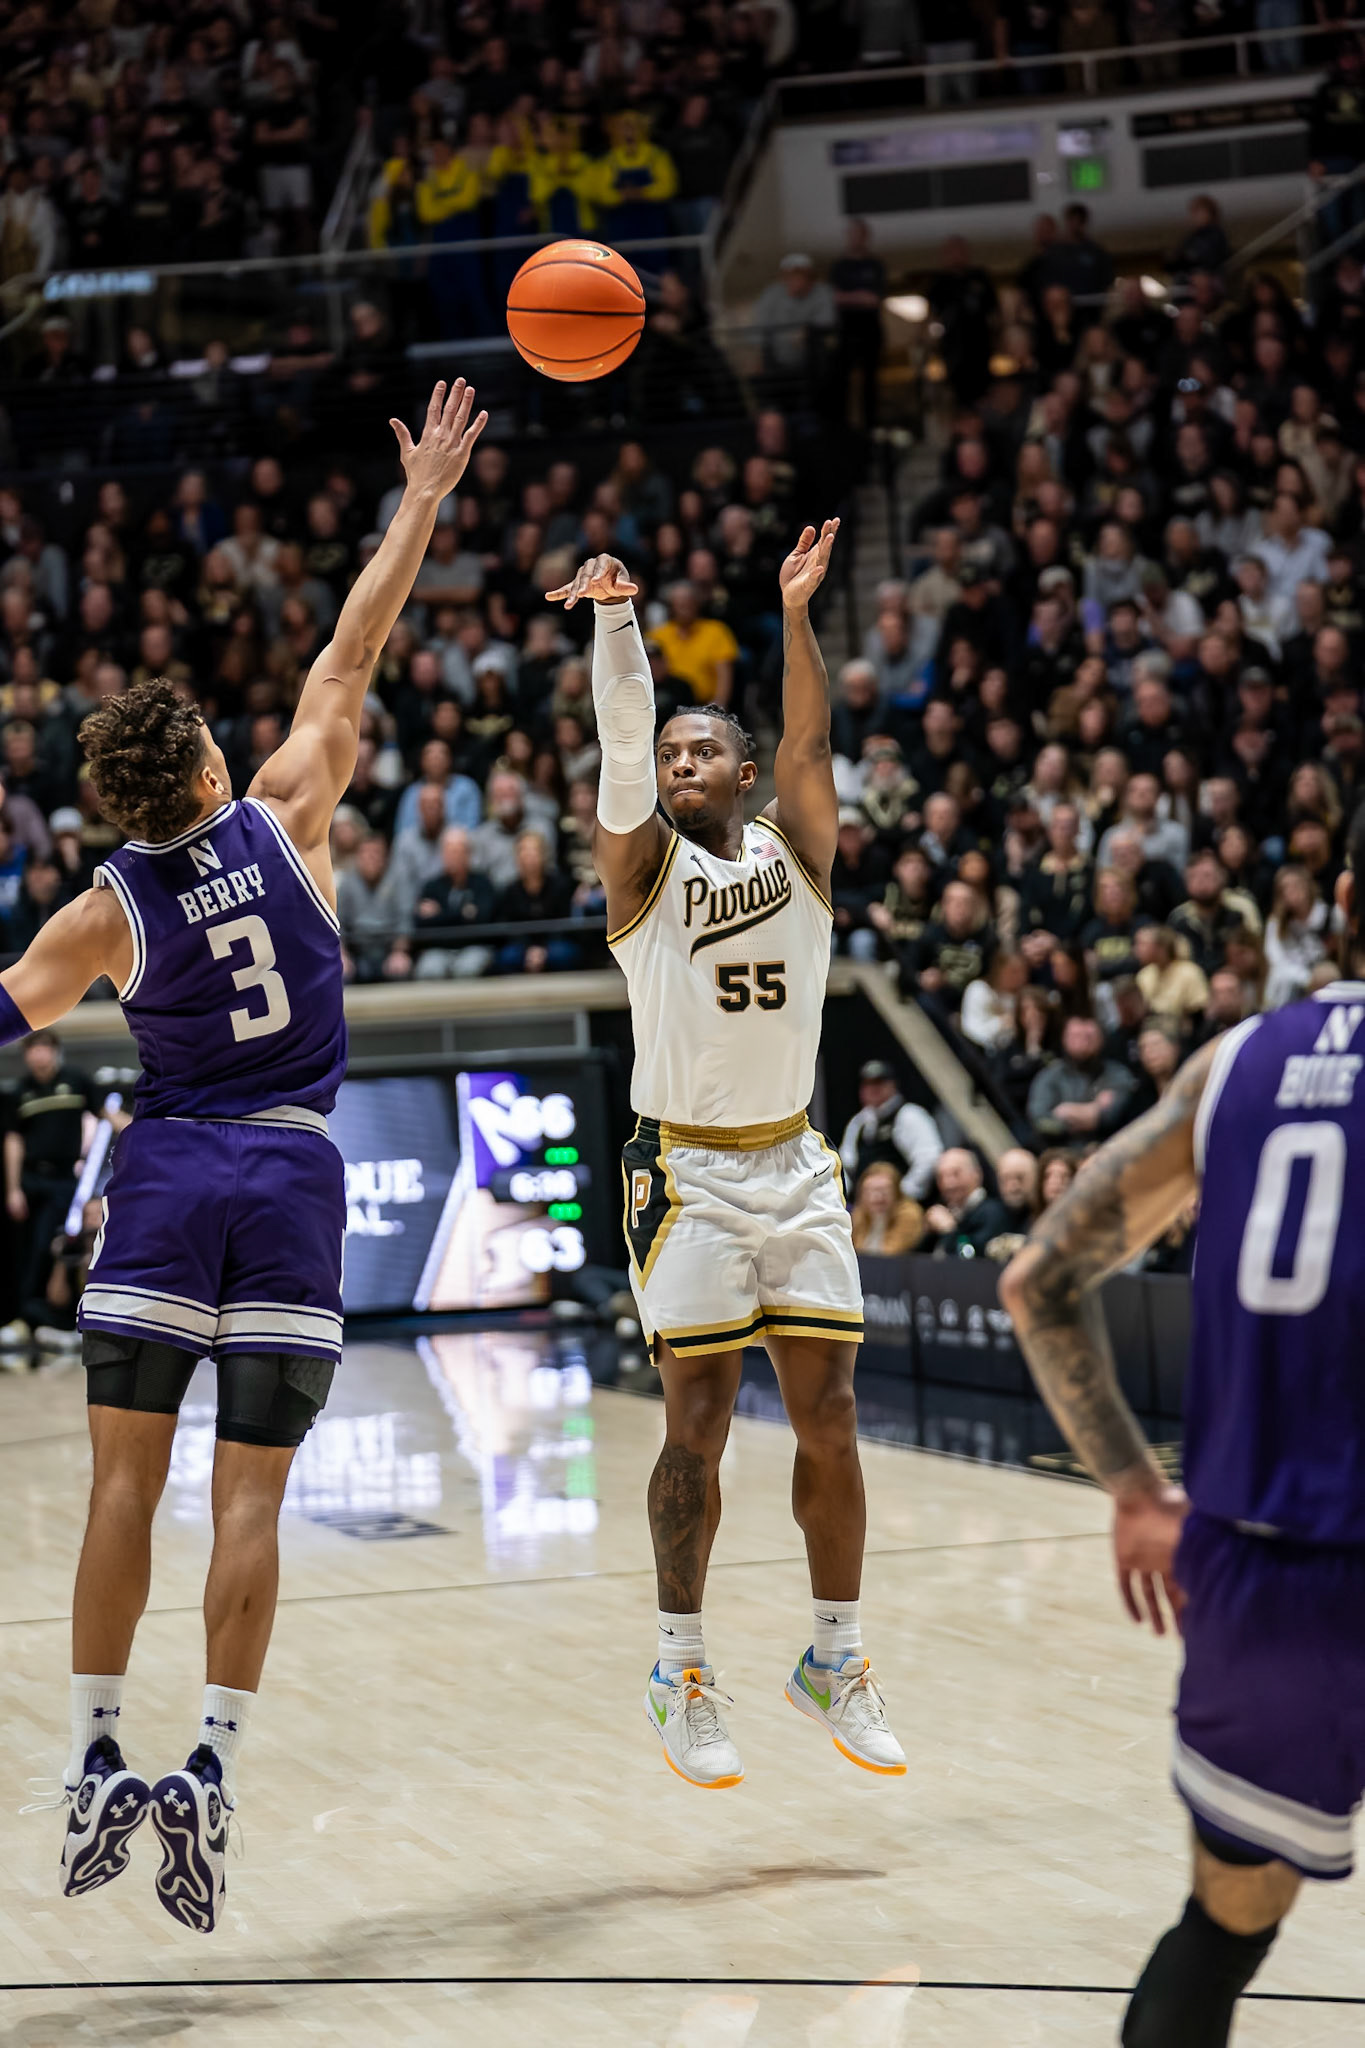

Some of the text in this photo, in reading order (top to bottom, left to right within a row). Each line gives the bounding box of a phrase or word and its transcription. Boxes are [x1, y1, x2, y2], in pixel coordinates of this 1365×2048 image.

[188, 839, 223, 876] N
[177, 863, 266, 924] BERRY
[682, 859, 792, 928] Purdue
[205, 914, 291, 1042] 3
[715, 960, 787, 1014] 55
[631, 1169, 652, 1229] P
[1237, 1120, 1347, 1315] 0
